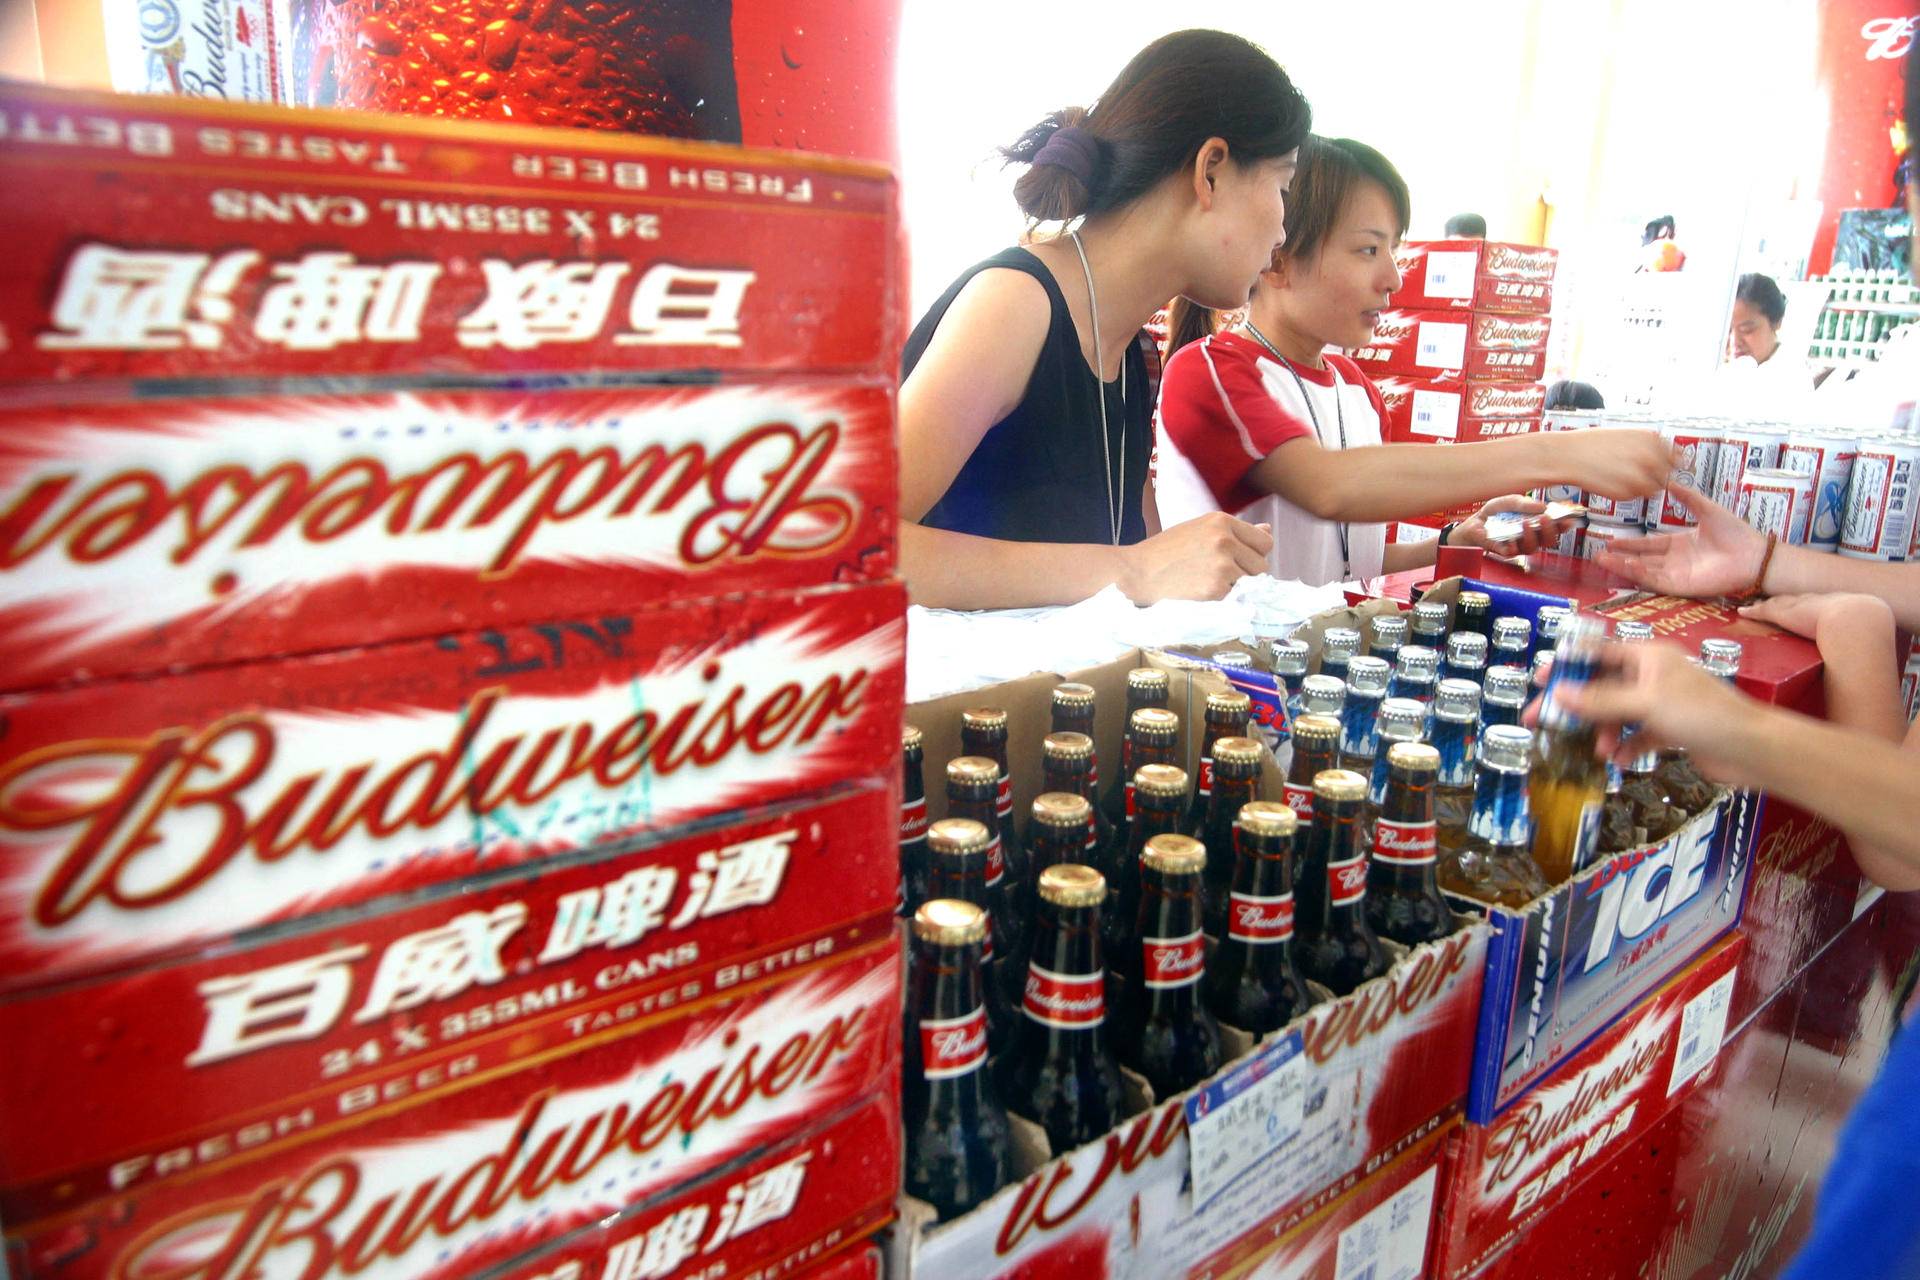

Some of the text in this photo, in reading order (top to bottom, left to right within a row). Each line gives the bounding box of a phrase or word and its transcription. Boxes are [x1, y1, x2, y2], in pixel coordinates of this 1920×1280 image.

[198, 126, 408, 174] TASTES
[208, 188, 370, 227] CANS
[512, 153, 648, 190] BEER
[565, 210, 596, 238] X
[608, 213, 660, 240] 24
[36, 244, 756, 351] 百威啤酒
[1472, 388, 1543, 411] Budweiser
[0, 662, 868, 929] Budweiser
[185, 828, 799, 1067] 百威啤酒
[1583, 804, 1720, 975] ICE
[110, 936, 836, 1190] FRESH BEER TASTES BETTER
[320, 941, 700, 1078] 24 X 355ML CANS
[108, 1005, 867, 1280] Budweiser
[1365, 1115, 1440, 1175] BETTER
[1486, 1031, 1669, 1194] Budweiser
[1507, 1099, 1640, 1220] 百威啤酒
[527, 1149, 814, 1280] 啤酒
